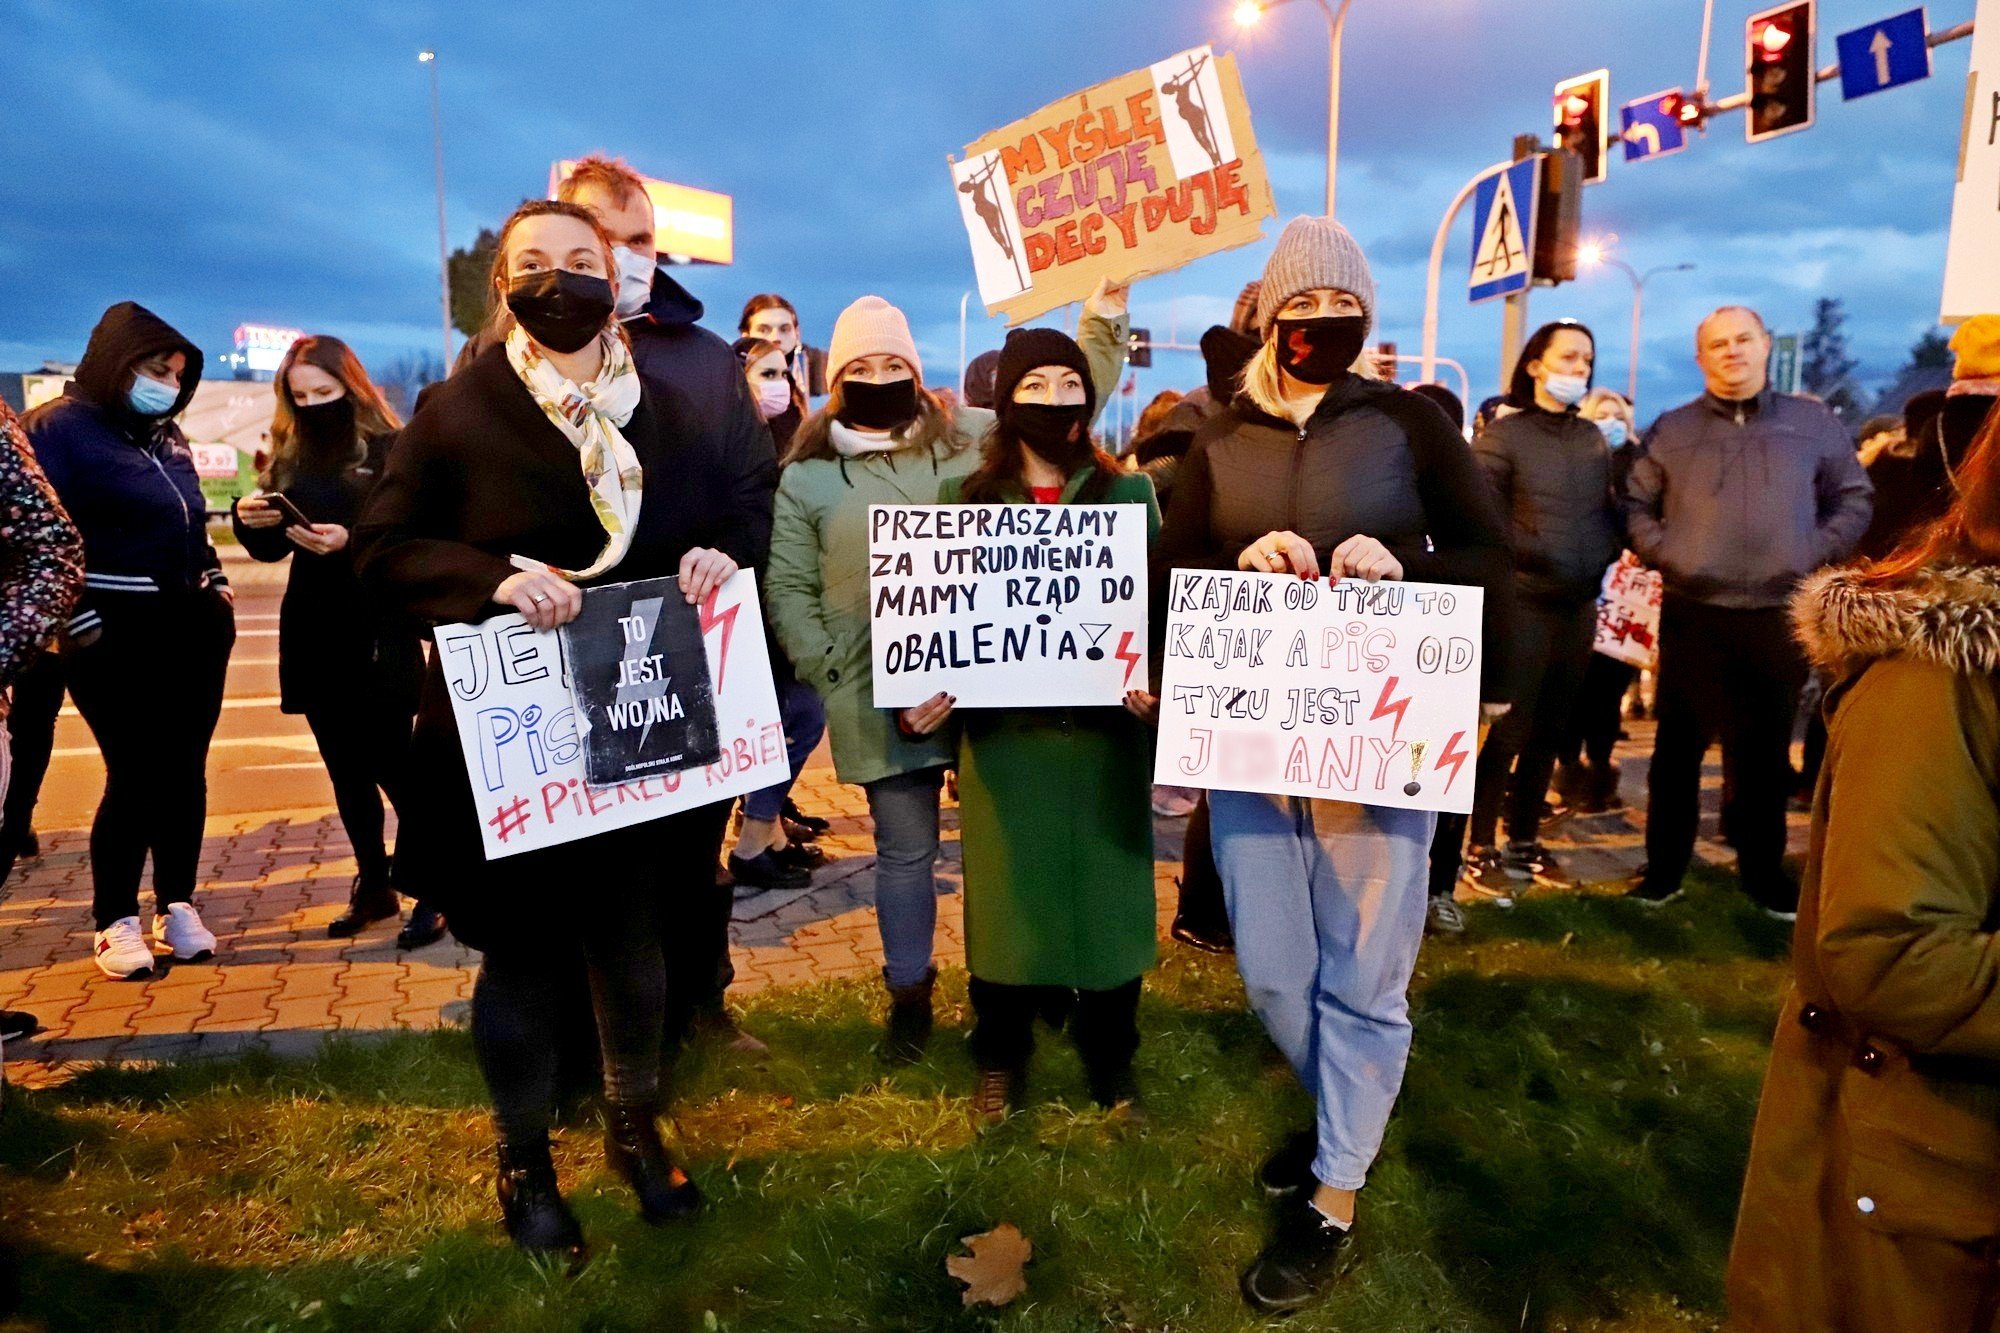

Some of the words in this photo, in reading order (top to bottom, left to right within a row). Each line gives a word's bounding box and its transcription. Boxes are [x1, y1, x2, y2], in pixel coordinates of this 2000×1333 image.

[999, 88, 1167, 185] MYŚLĘ
[1016, 140, 1160, 228] CZUJĘ
[1023, 158, 1250, 274] DECYDUJĘ
[872, 507, 1118, 543] PRZEPRASZAMY
[871, 552, 913, 577] ZA
[875, 582, 978, 618] MAMY
[1006, 575, 1081, 614] RZĄD
[1102, 575, 1135, 604] DO
[1170, 574, 1273, 621] KAJAK
[1284, 581, 1318, 610] OD
[1330, 582, 1404, 615] TYŁU
[1415, 591, 1456, 616] TO
[617, 614, 647, 645] TO
[1169, 623, 1272, 669] KAJAK
[1286, 629, 1308, 668] A
[1416, 636, 1474, 674] OD
[614, 653, 665, 689] JEST
[605, 692, 685, 732] WOJNA
[1173, 685, 1269, 720] TYŁU
[1280, 687, 1360, 730] JEST
